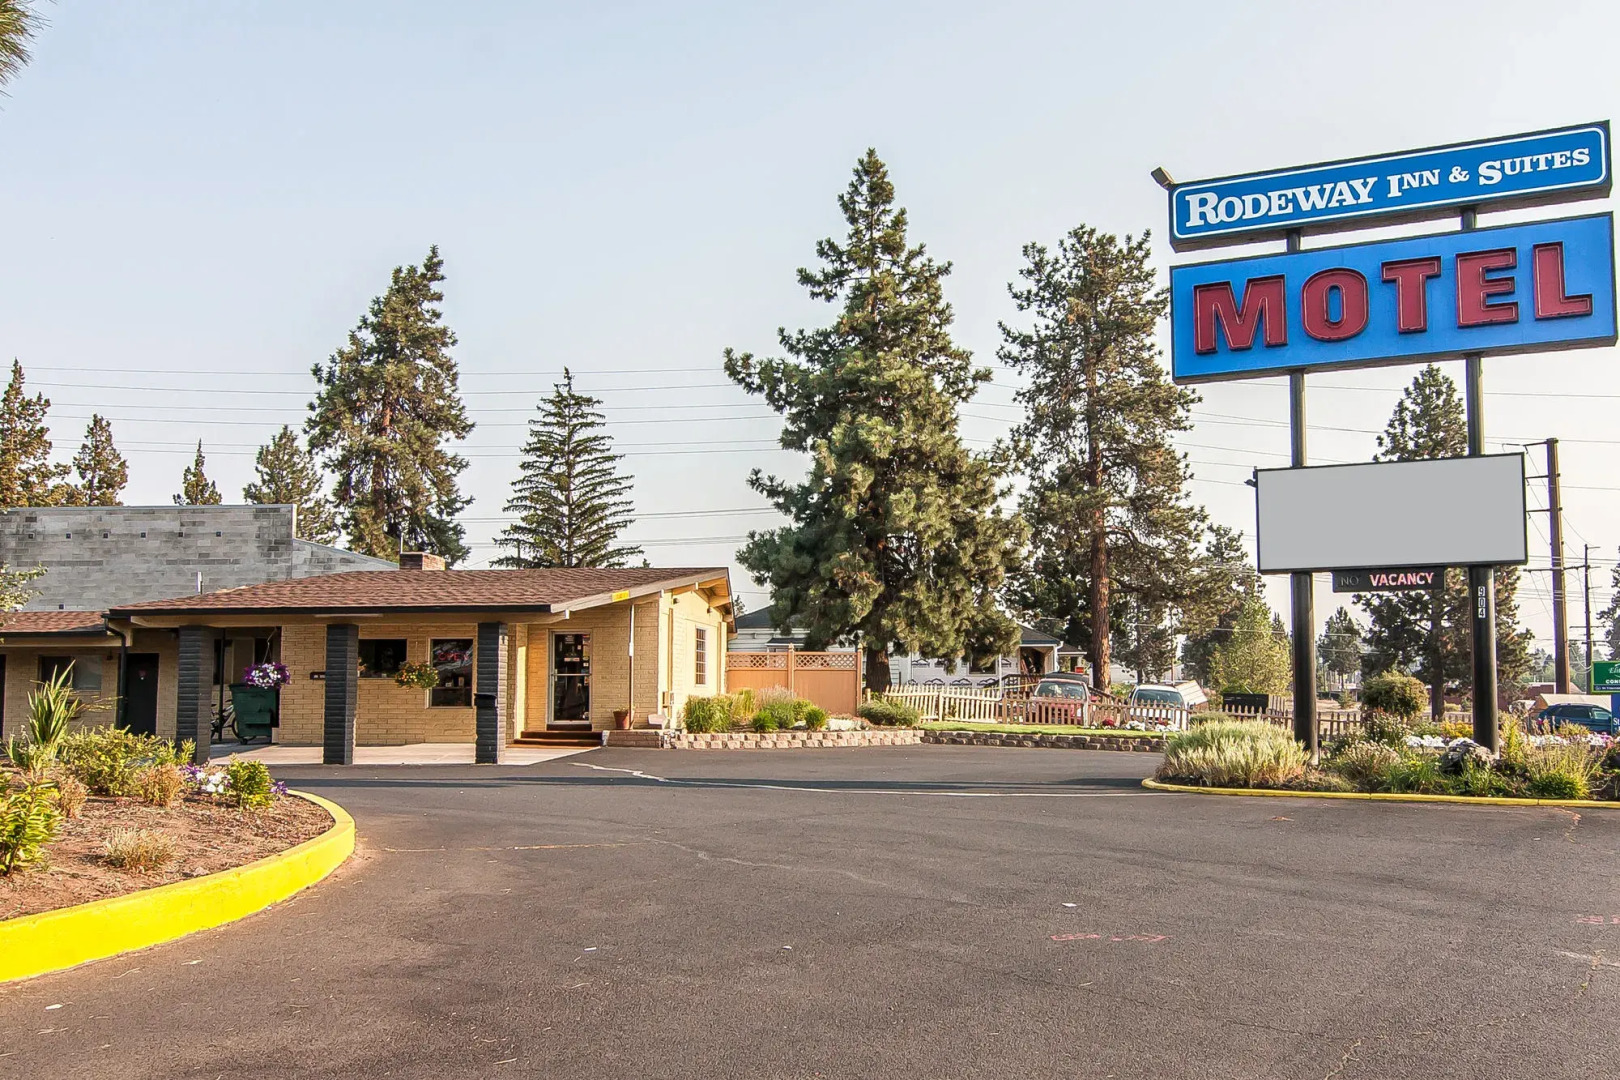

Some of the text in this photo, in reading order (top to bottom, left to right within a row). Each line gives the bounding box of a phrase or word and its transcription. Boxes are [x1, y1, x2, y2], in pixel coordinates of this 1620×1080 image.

[1185, 147, 1590, 228] RODEWAY INN & SUITES
[1192, 241, 1593, 355] MOTEL
[1340, 572, 1434, 587] NO VACANCY
[1478, 586, 1486, 618] 904
